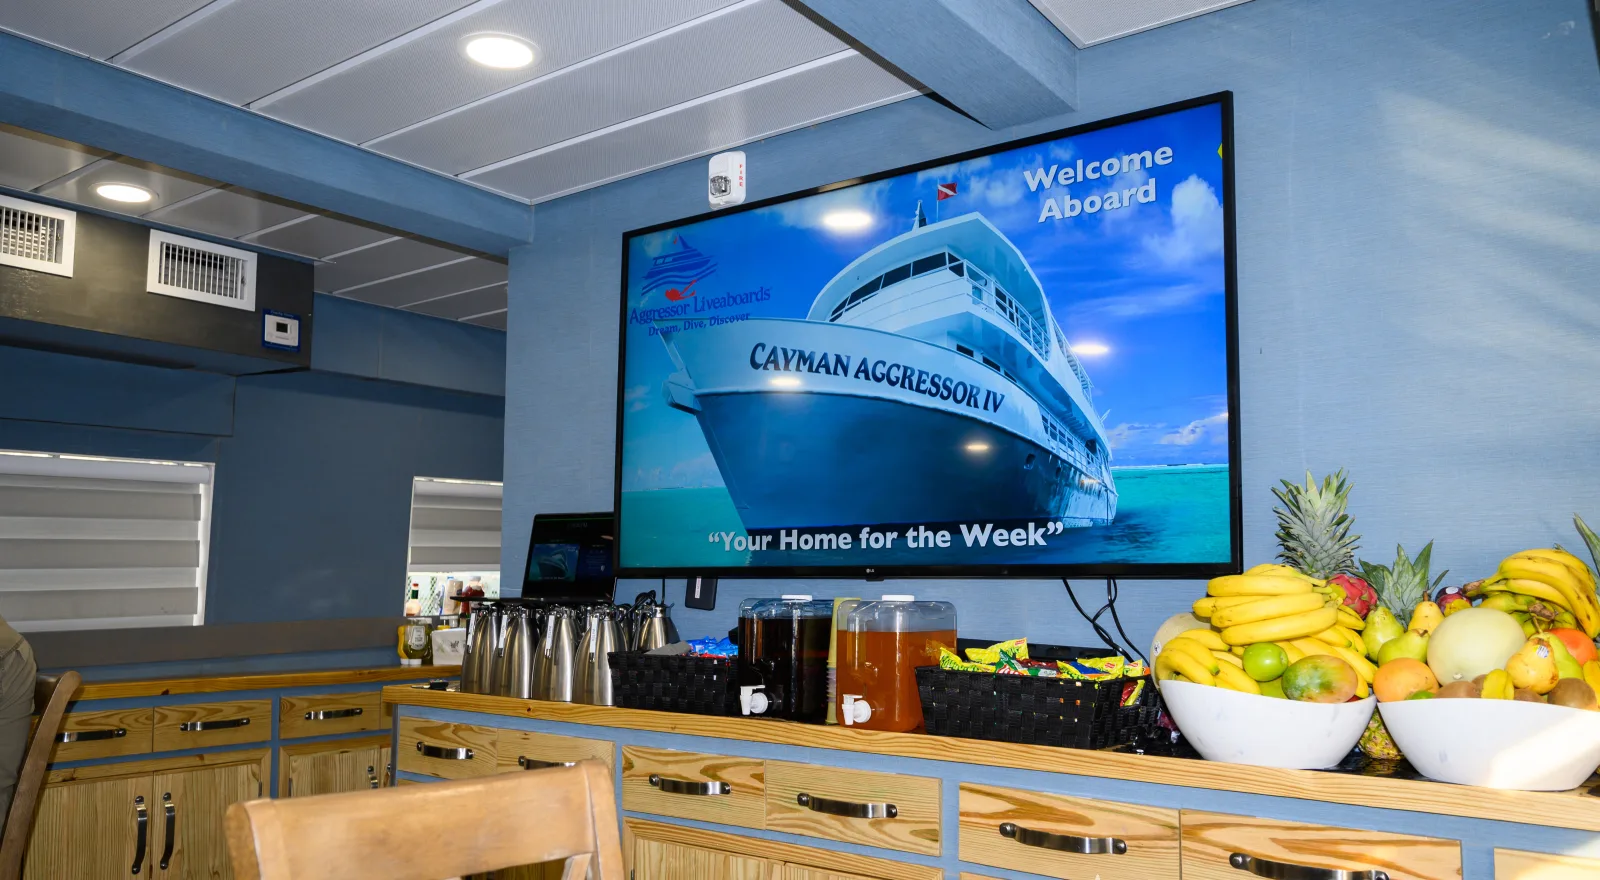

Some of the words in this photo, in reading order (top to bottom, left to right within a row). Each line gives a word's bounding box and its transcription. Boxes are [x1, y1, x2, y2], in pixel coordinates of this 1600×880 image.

[1023, 146, 1173, 192] Welcome
[1038, 178, 1156, 223] Aboard
[629, 301, 690, 325] Aggressor
[693, 286, 772, 313] Liveaboards
[648, 325, 681, 336] Dream,
[683, 320, 707, 331] Dive,
[709, 312, 751, 327] Discover
[749, 342, 851, 377] CAYMAN
[853, 357, 980, 409] AGGRESSOR
[983, 389, 1006, 413] IV
[779, 529, 853, 550] Home
[859, 527, 898, 549] for
[905, 525, 952, 548] the
